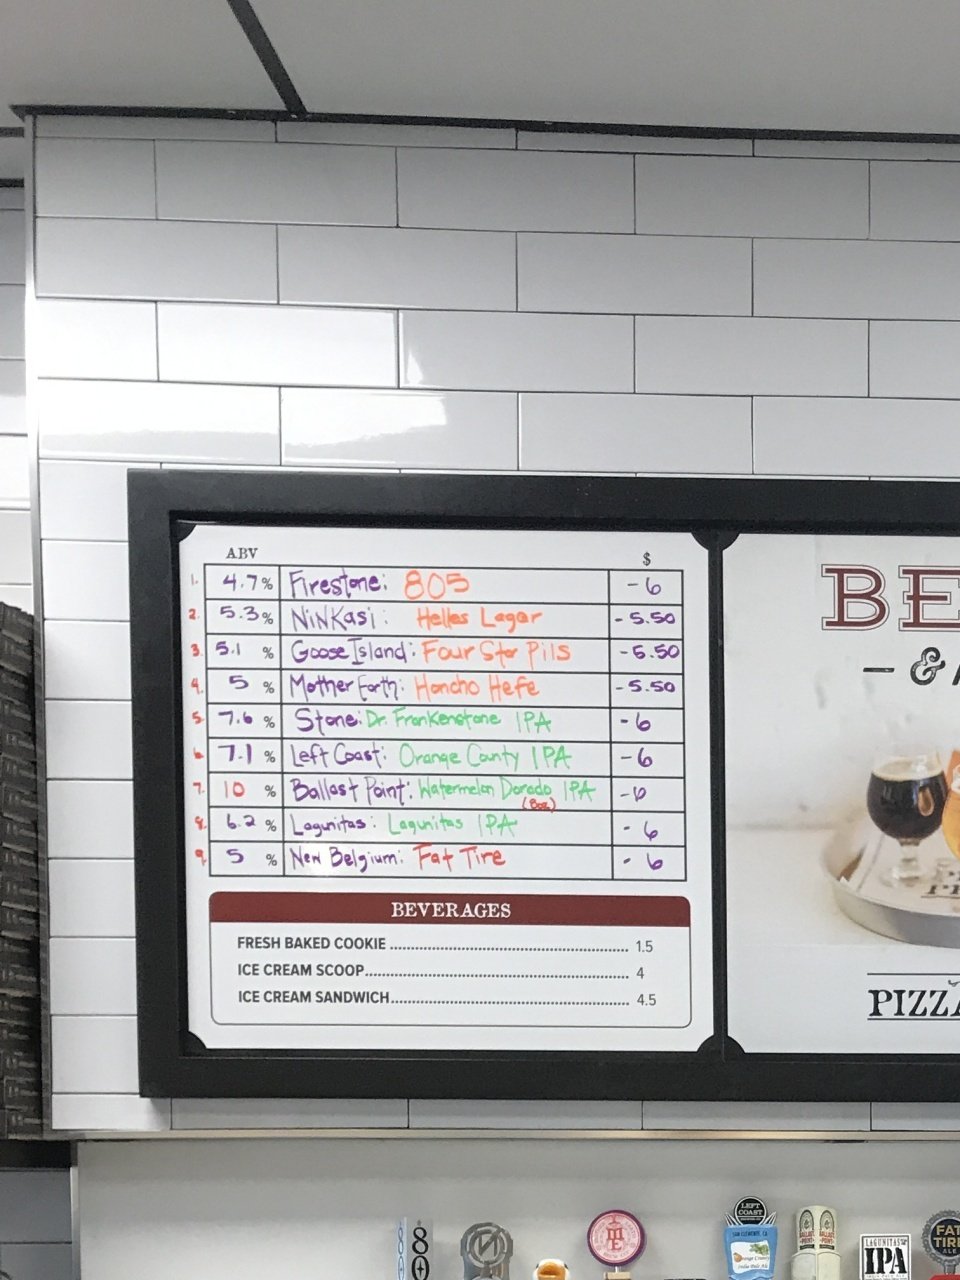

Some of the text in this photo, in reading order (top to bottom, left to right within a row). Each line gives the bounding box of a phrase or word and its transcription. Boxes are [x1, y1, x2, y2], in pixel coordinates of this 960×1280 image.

[226, 547, 258, 560] ABV
[643, 552, 651, 566] $
[289, 568, 469, 600] Firestone: 805
[417, 606, 468, 631] Helles
[481, 607, 542, 633] Lager
[291, 639, 349, 663] Goose
[421, 639, 474, 663] Four
[479, 641, 518, 668] Star
[526, 642, 571, 669] Pils
[910, 647, 946, 686] &
[289, 674, 354, 701] Mother
[414, 673, 480, 701] Honcho
[488, 674, 540, 702] Hefe
[516, 710, 552, 733] IPA
[291, 744, 329, 769] Left
[399, 743, 461, 768] Orange
[467, 743, 520, 771] County
[532, 745, 572, 770] IPA
[290, 777, 358, 802] Ballast
[418, 777, 494, 799] Watermelon
[500, 776, 552, 799] Dorado
[563, 779, 596, 802] IPA
[388, 812, 463, 835] Lagunitas
[478, 813, 517, 837] IPA
[289, 845, 321, 869] New
[412, 841, 454, 872] Fat
[459, 846, 506, 870] Tire
[391, 902, 511, 918] BEVERAGES
[237, 937, 653, 953] FRESH BAKED COOKIE 1.5
[237, 963, 645, 979] ICE CREAM SCOOP 4
[238, 990, 657, 1006] ICE CREAM SANDWICH 4.5
[865, 1238, 900, 1246] LAGUNITAS
[864, 1247, 907, 1274] IPA
